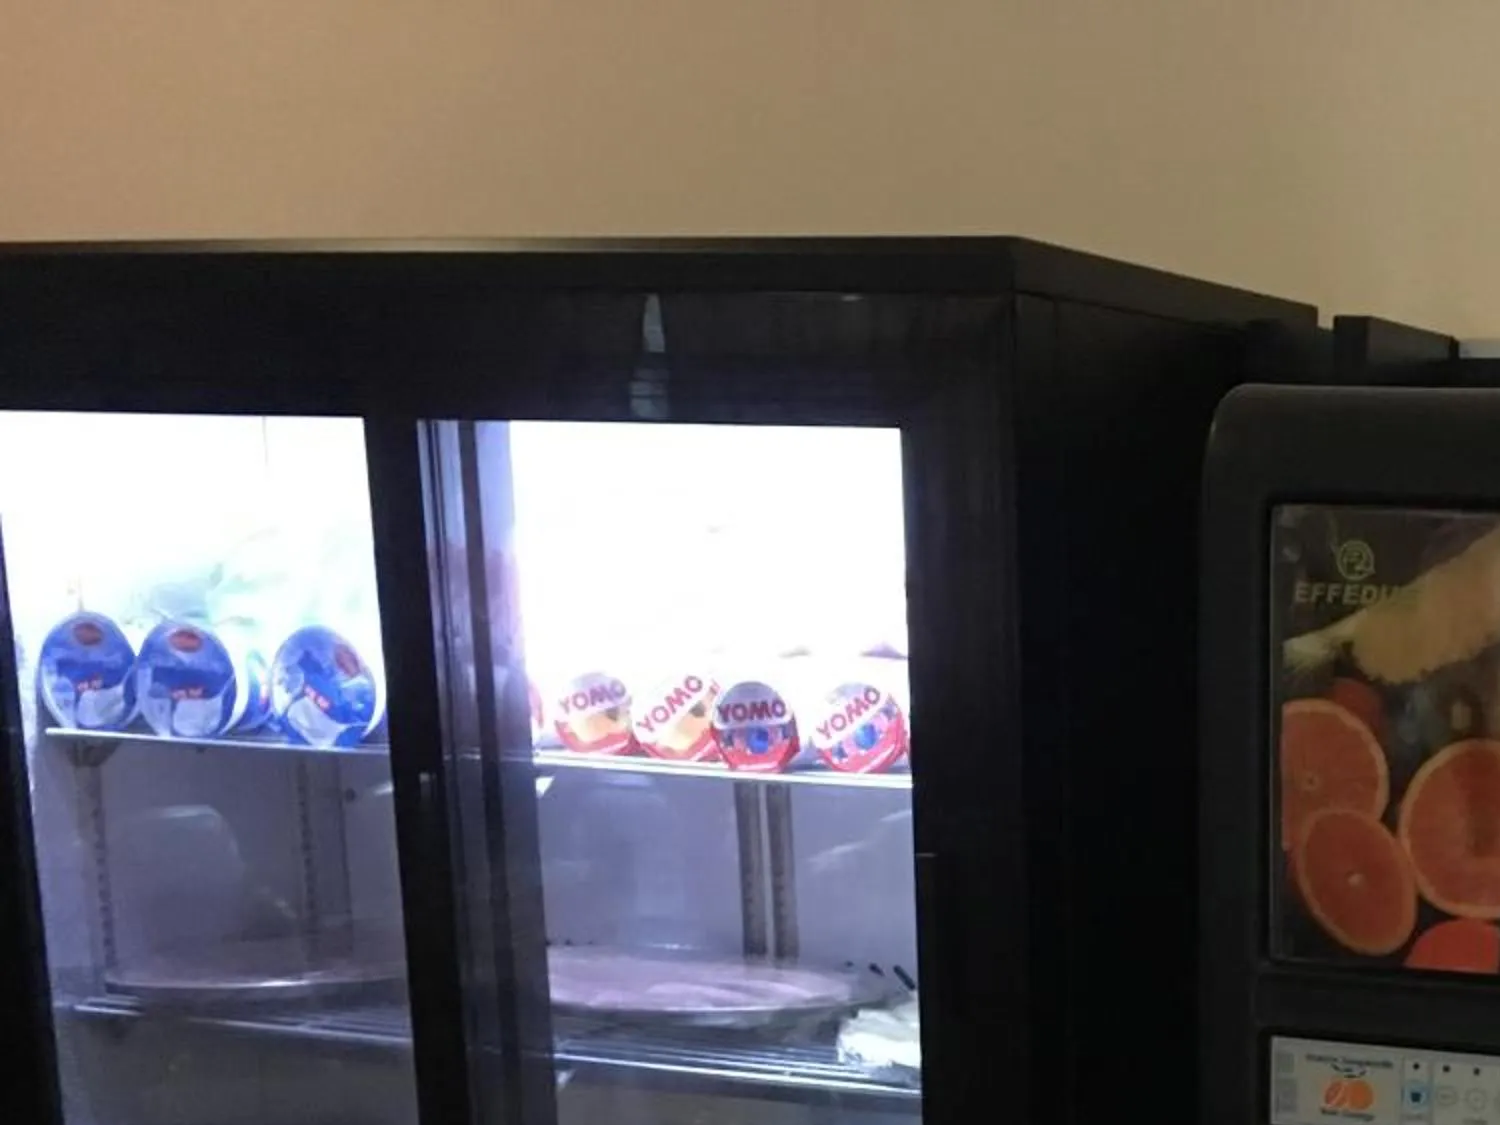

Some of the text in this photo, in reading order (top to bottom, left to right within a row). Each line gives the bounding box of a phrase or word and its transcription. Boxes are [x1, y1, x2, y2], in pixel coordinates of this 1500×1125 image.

[1294, 579, 1414, 606] EFFEDU
[558, 679, 627, 716] YOMO
[637, 674, 704, 735] YOMO
[716, 699, 787, 723] YOMO
[816, 686, 881, 741] YOMO
